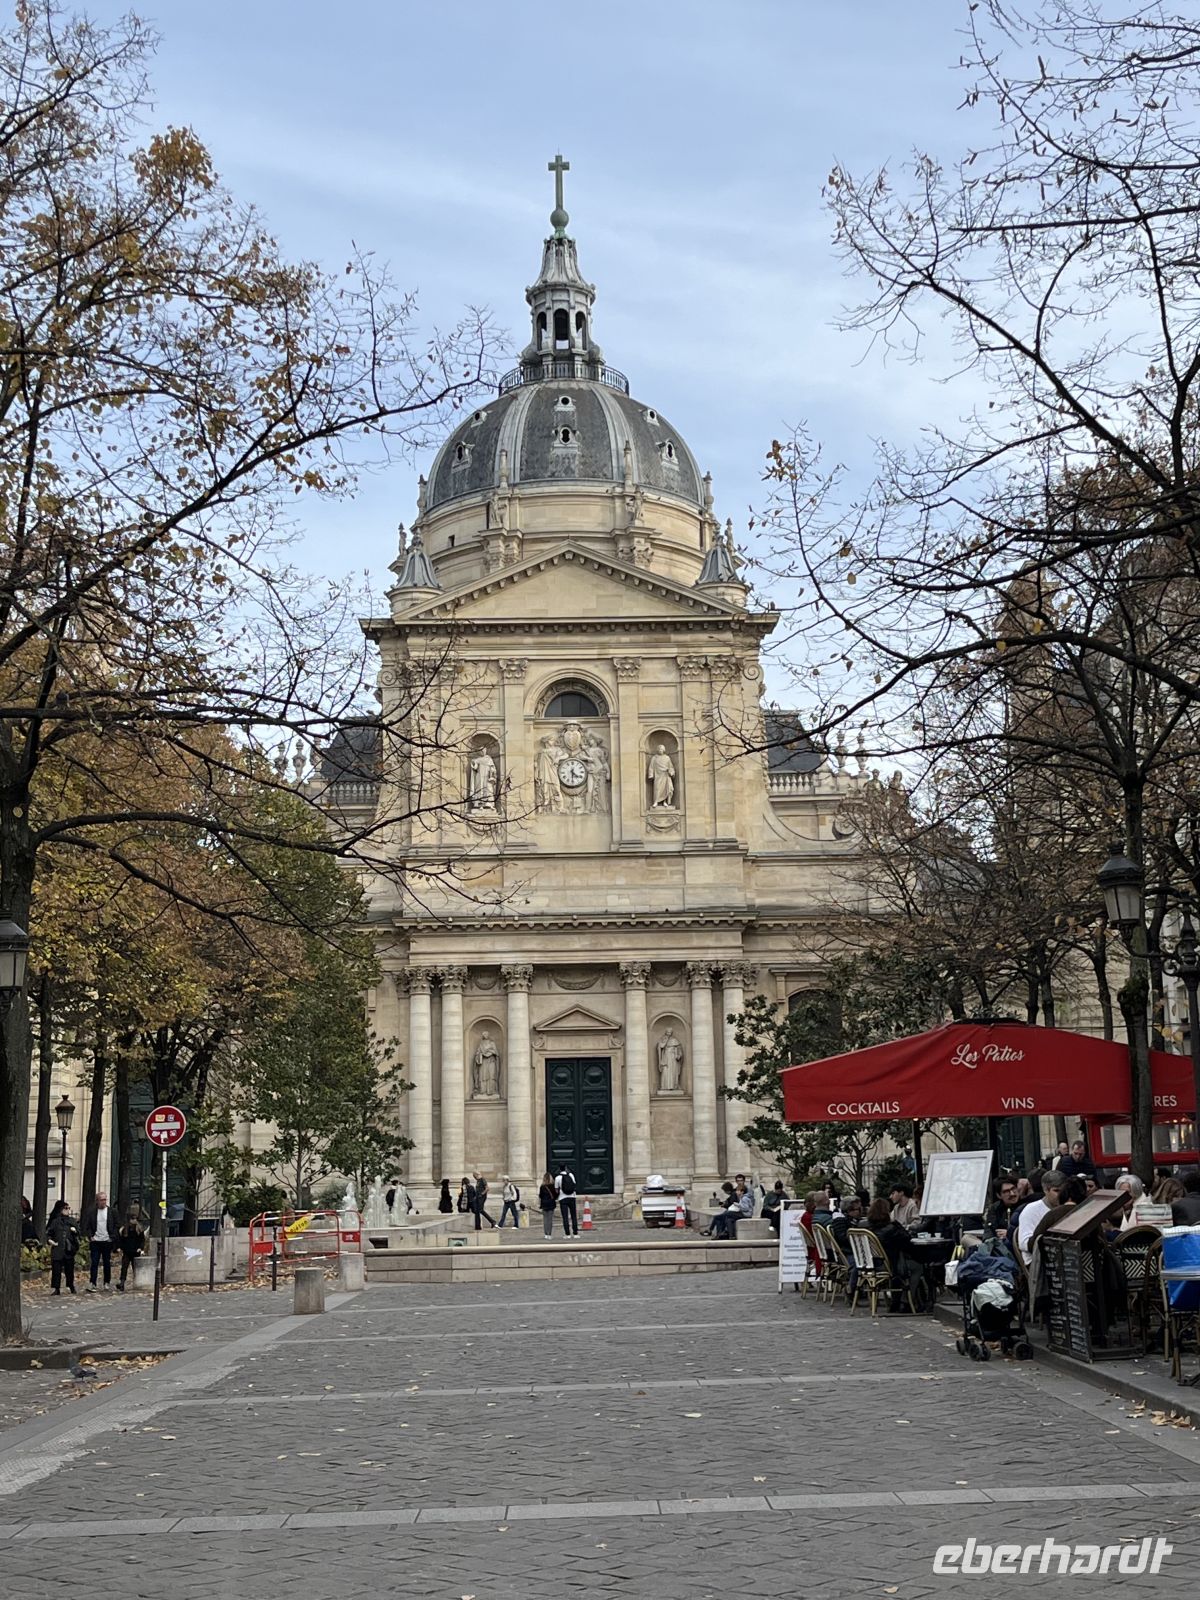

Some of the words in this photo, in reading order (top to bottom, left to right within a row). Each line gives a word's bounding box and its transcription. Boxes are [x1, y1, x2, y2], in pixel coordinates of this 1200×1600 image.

[950, 1043, 980, 1069] Les
[982, 1043, 1025, 1062] Patios
[1001, 1097, 1035, 1109] VINS
[1153, 1095, 1178, 1107] RES
[827, 1101, 900, 1115] COCKTAILS
